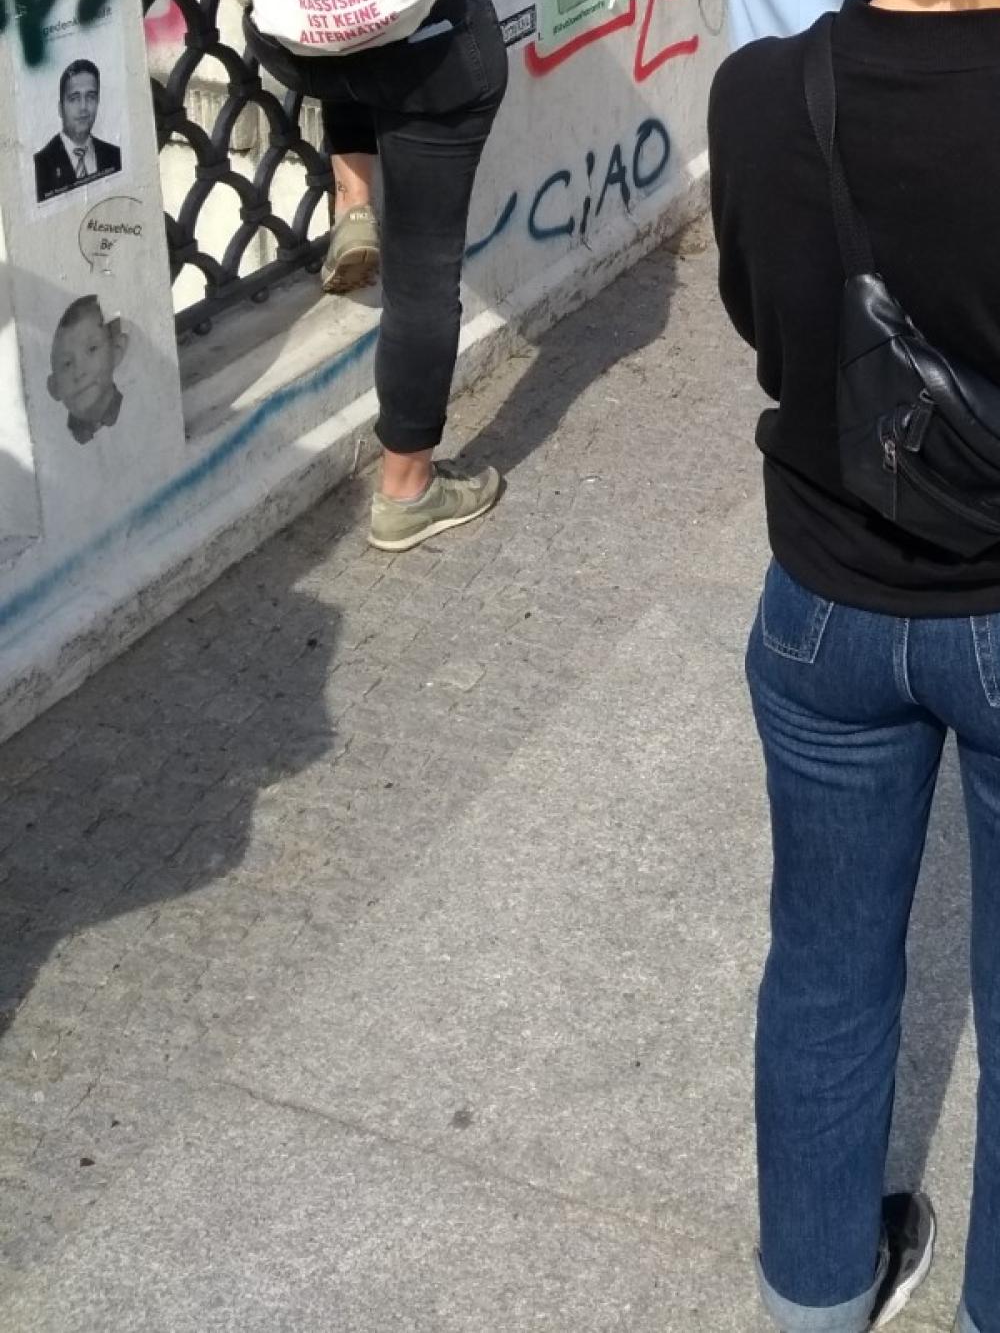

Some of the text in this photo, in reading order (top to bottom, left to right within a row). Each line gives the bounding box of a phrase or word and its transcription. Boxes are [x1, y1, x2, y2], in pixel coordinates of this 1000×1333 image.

[300, 10, 400, 44] ALTERNATIVE
[307, 3, 381, 28] IST KEINE
